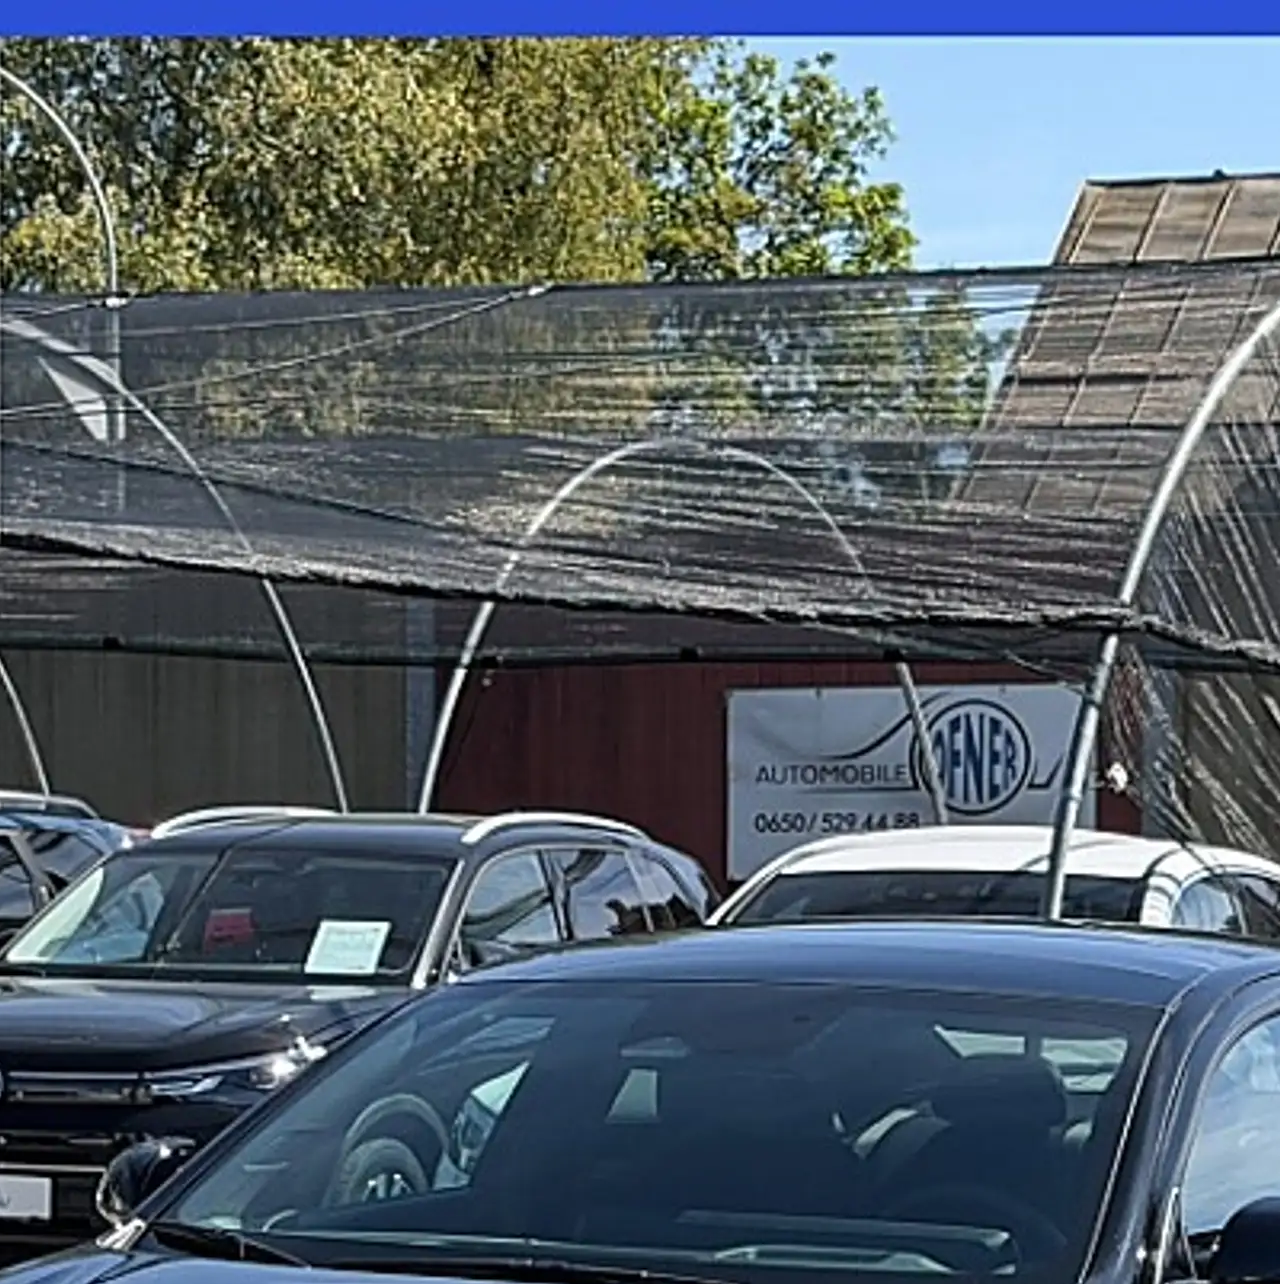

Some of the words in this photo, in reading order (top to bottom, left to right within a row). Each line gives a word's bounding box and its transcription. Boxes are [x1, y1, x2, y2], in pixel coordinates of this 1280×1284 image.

[754, 763, 908, 786] AUTOMOBILE
[821, 812, 857, 832] 529
[862, 813, 888, 831] 44
